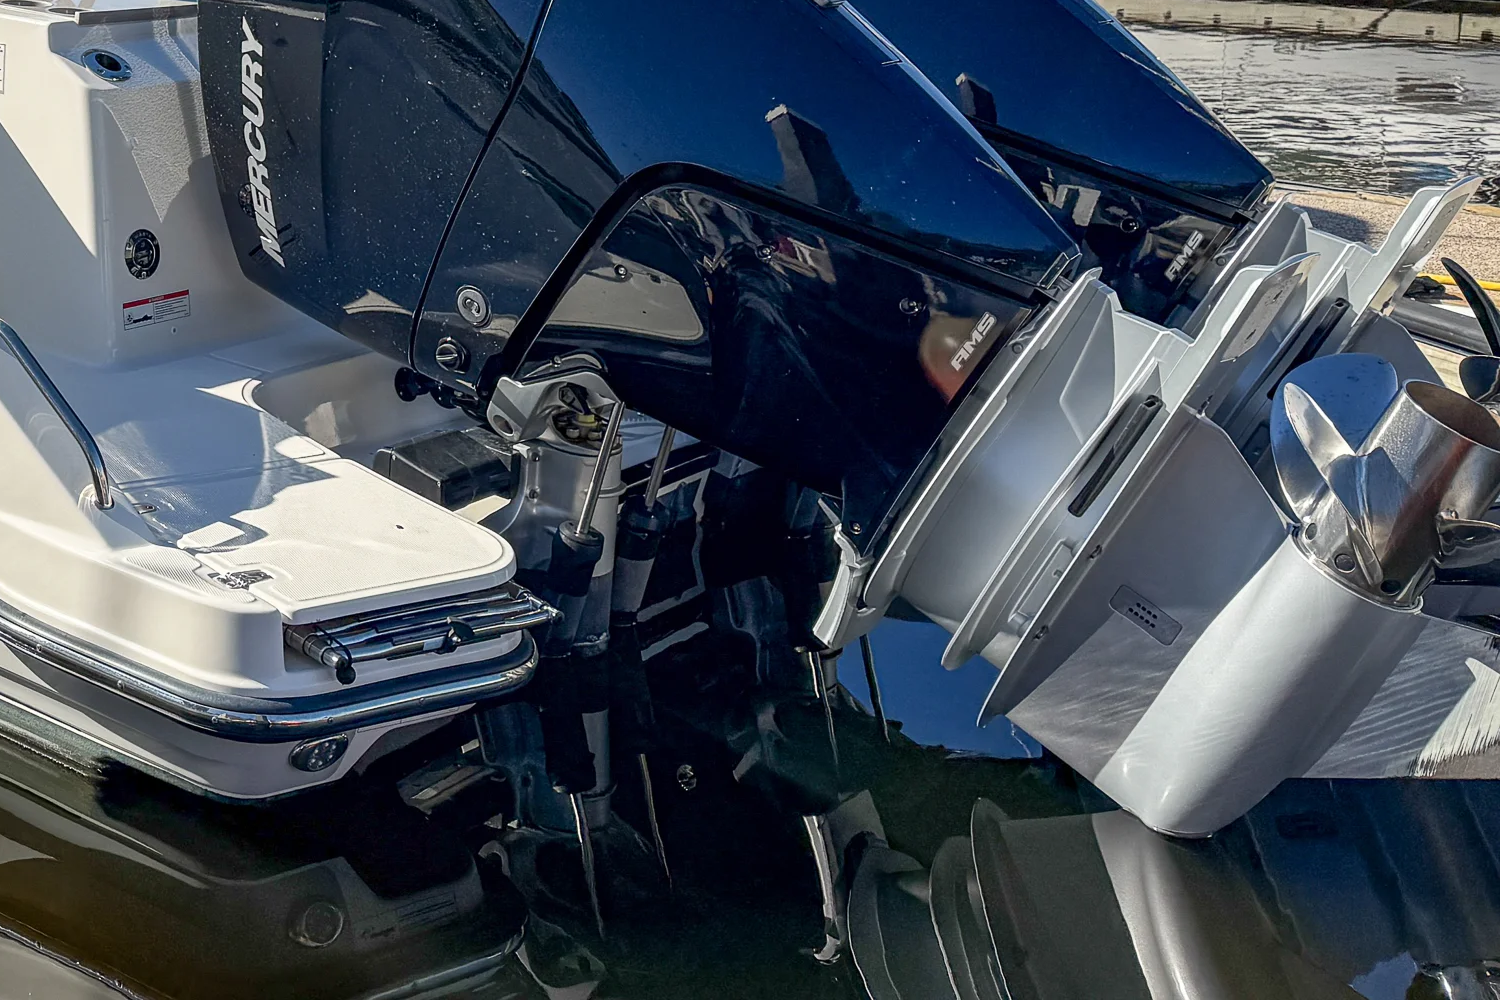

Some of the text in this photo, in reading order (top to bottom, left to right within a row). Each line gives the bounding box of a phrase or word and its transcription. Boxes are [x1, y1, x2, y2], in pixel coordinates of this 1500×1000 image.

[241, 16, 285, 268] MERCURY
[1164, 230, 1203, 282] AMS
[951, 313, 995, 371] AMS
